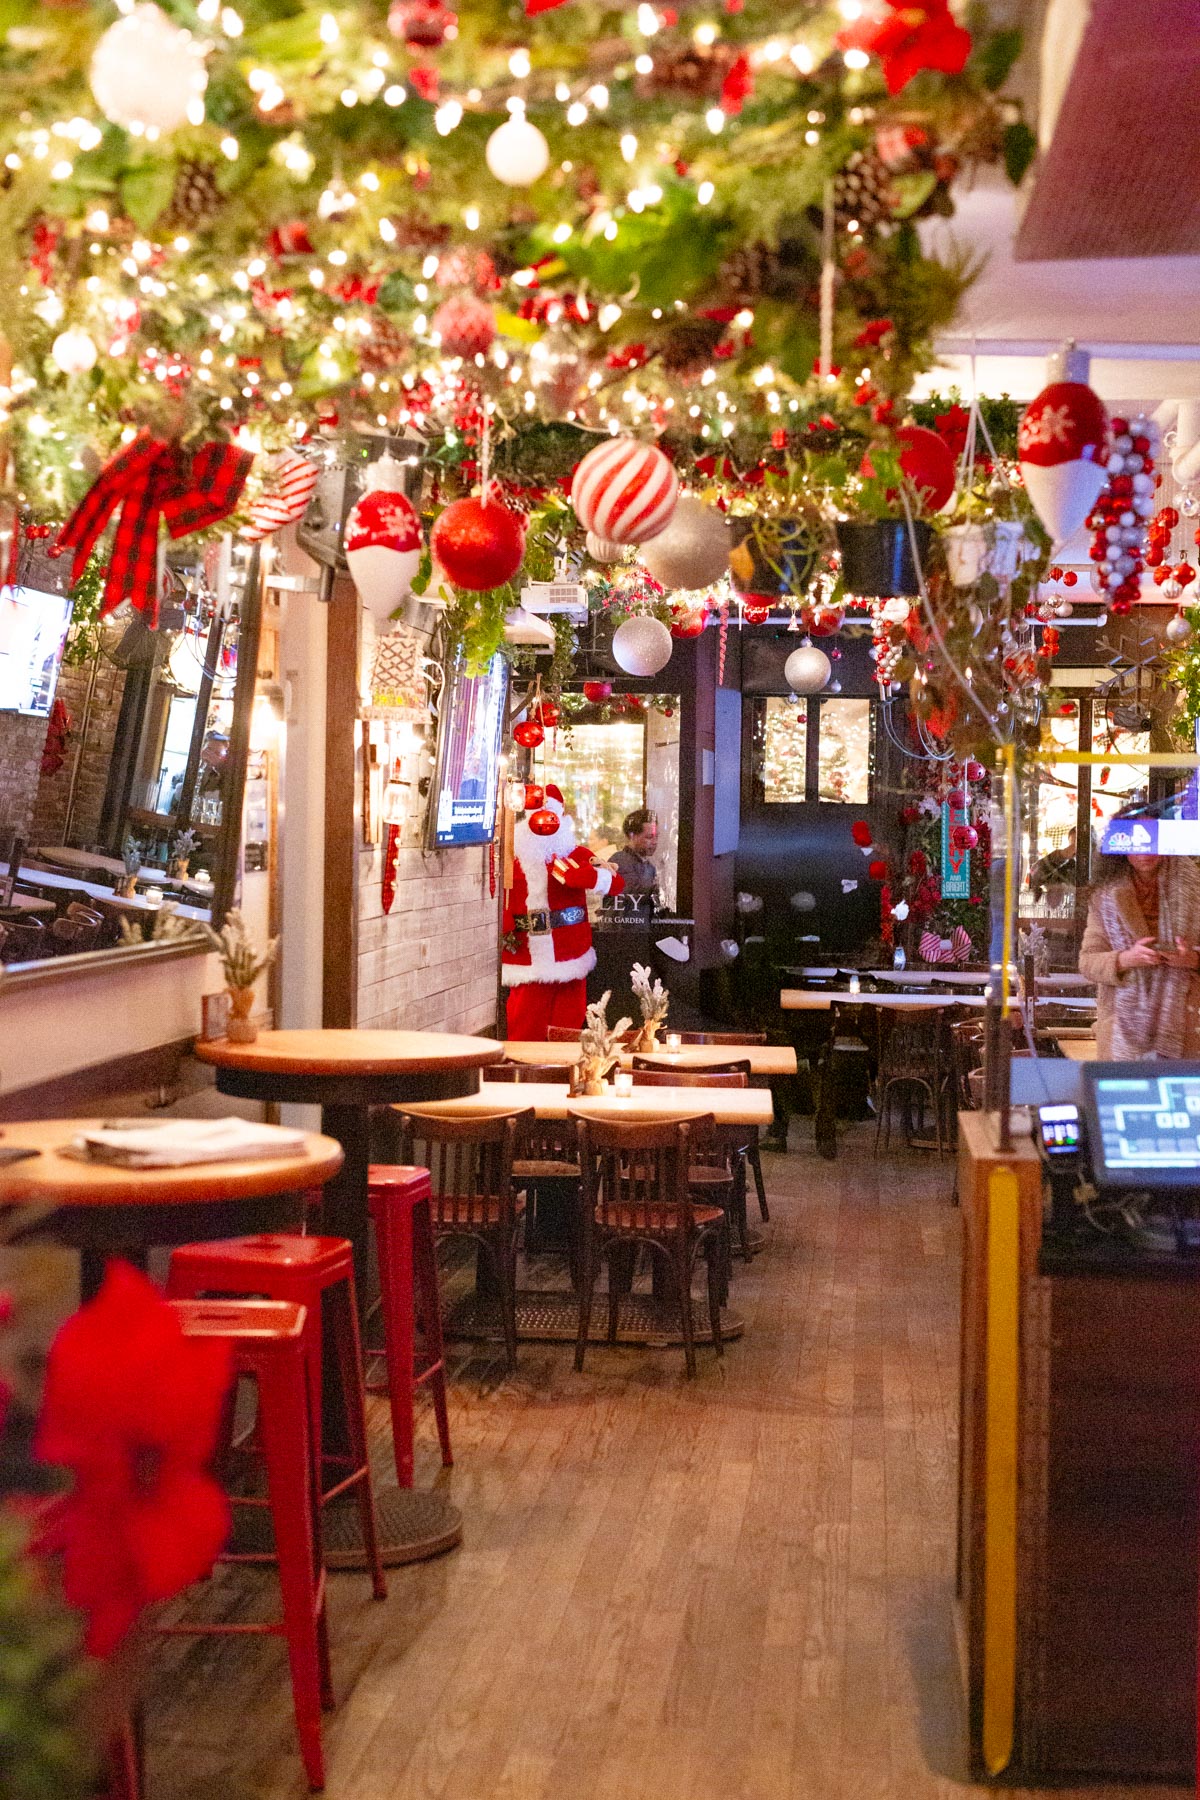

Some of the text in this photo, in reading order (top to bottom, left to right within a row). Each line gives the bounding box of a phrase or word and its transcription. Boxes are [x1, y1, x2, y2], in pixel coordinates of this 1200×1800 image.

[945, 881, 965, 892] BRIGHT
[599, 893, 645, 912] LEY
[614, 916, 645, 924] GARDEN
